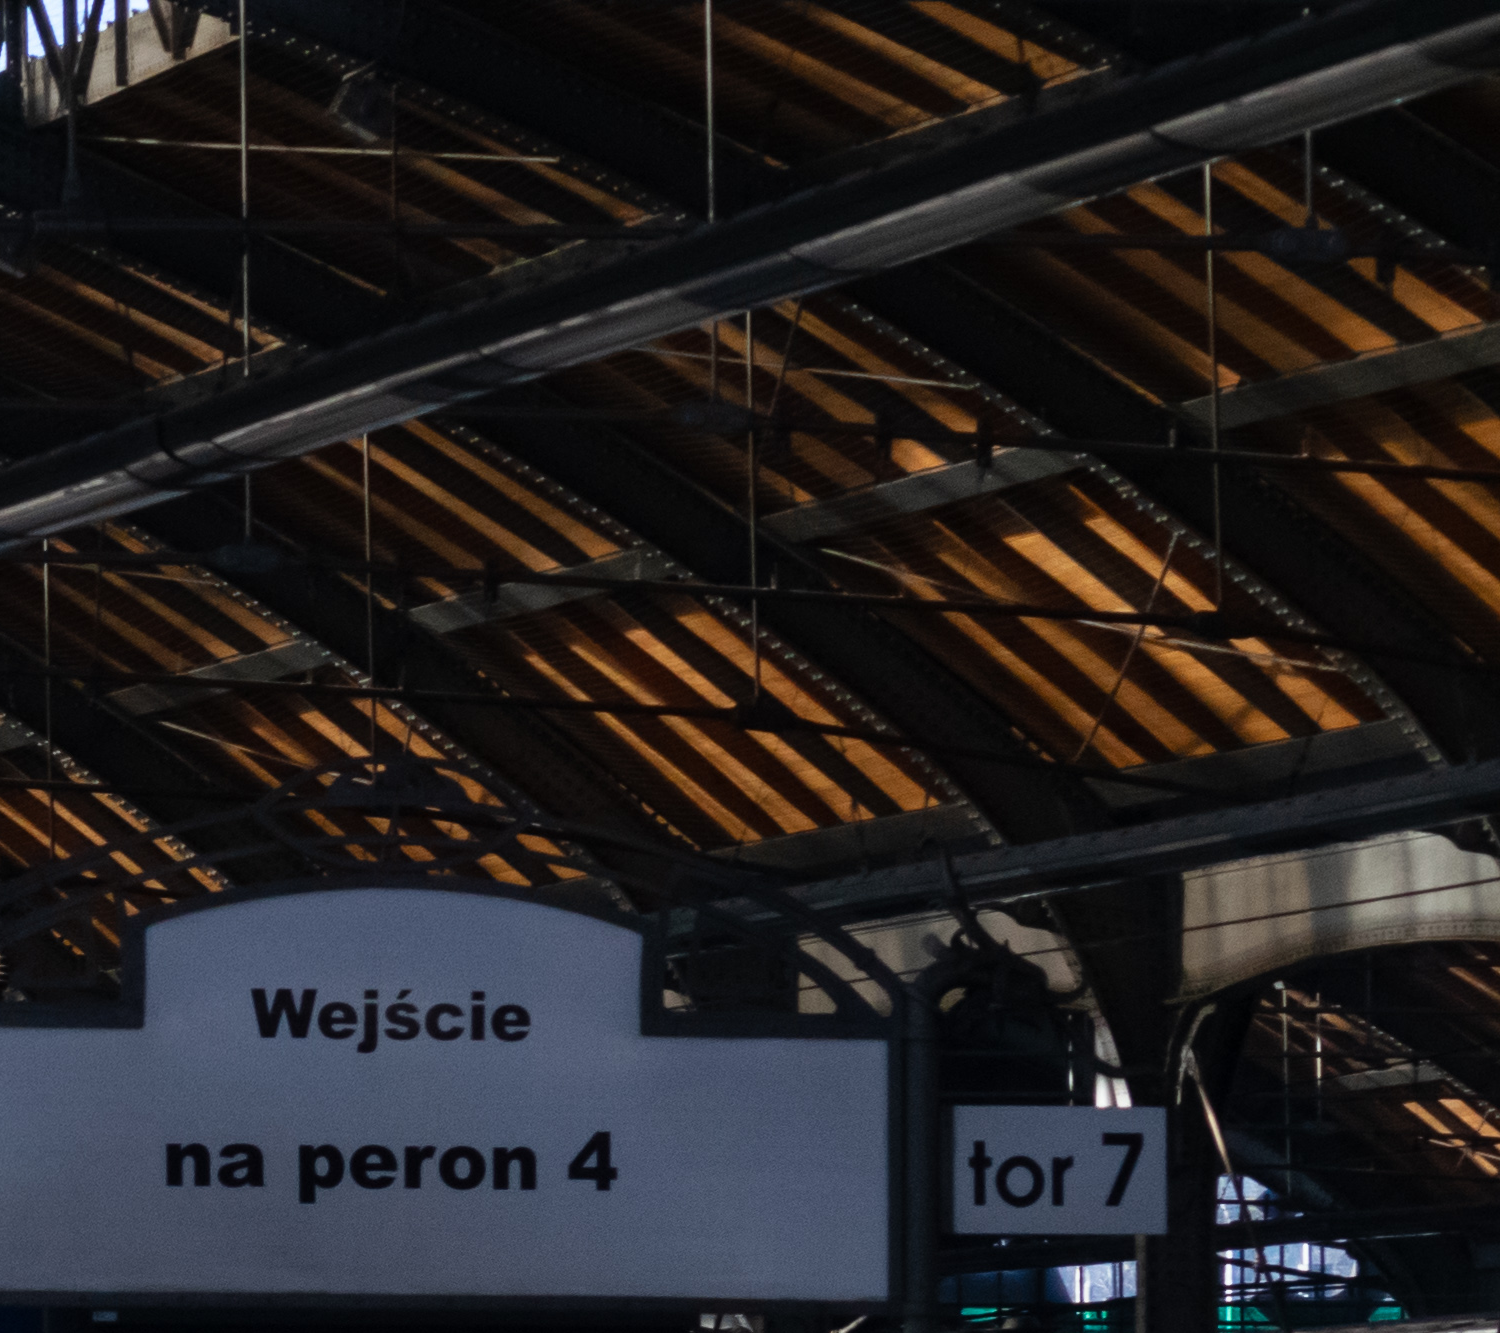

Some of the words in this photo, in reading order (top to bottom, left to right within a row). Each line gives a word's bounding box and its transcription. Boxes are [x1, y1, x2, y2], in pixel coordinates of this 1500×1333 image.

[251, 988, 533, 1055] Wejście
[164, 1142, 267, 1189] na
[298, 1142, 539, 1204] peron
[567, 1131, 619, 1192] 4
[968, 1139, 1076, 1208] tor
[1101, 1131, 1145, 1208] 7
